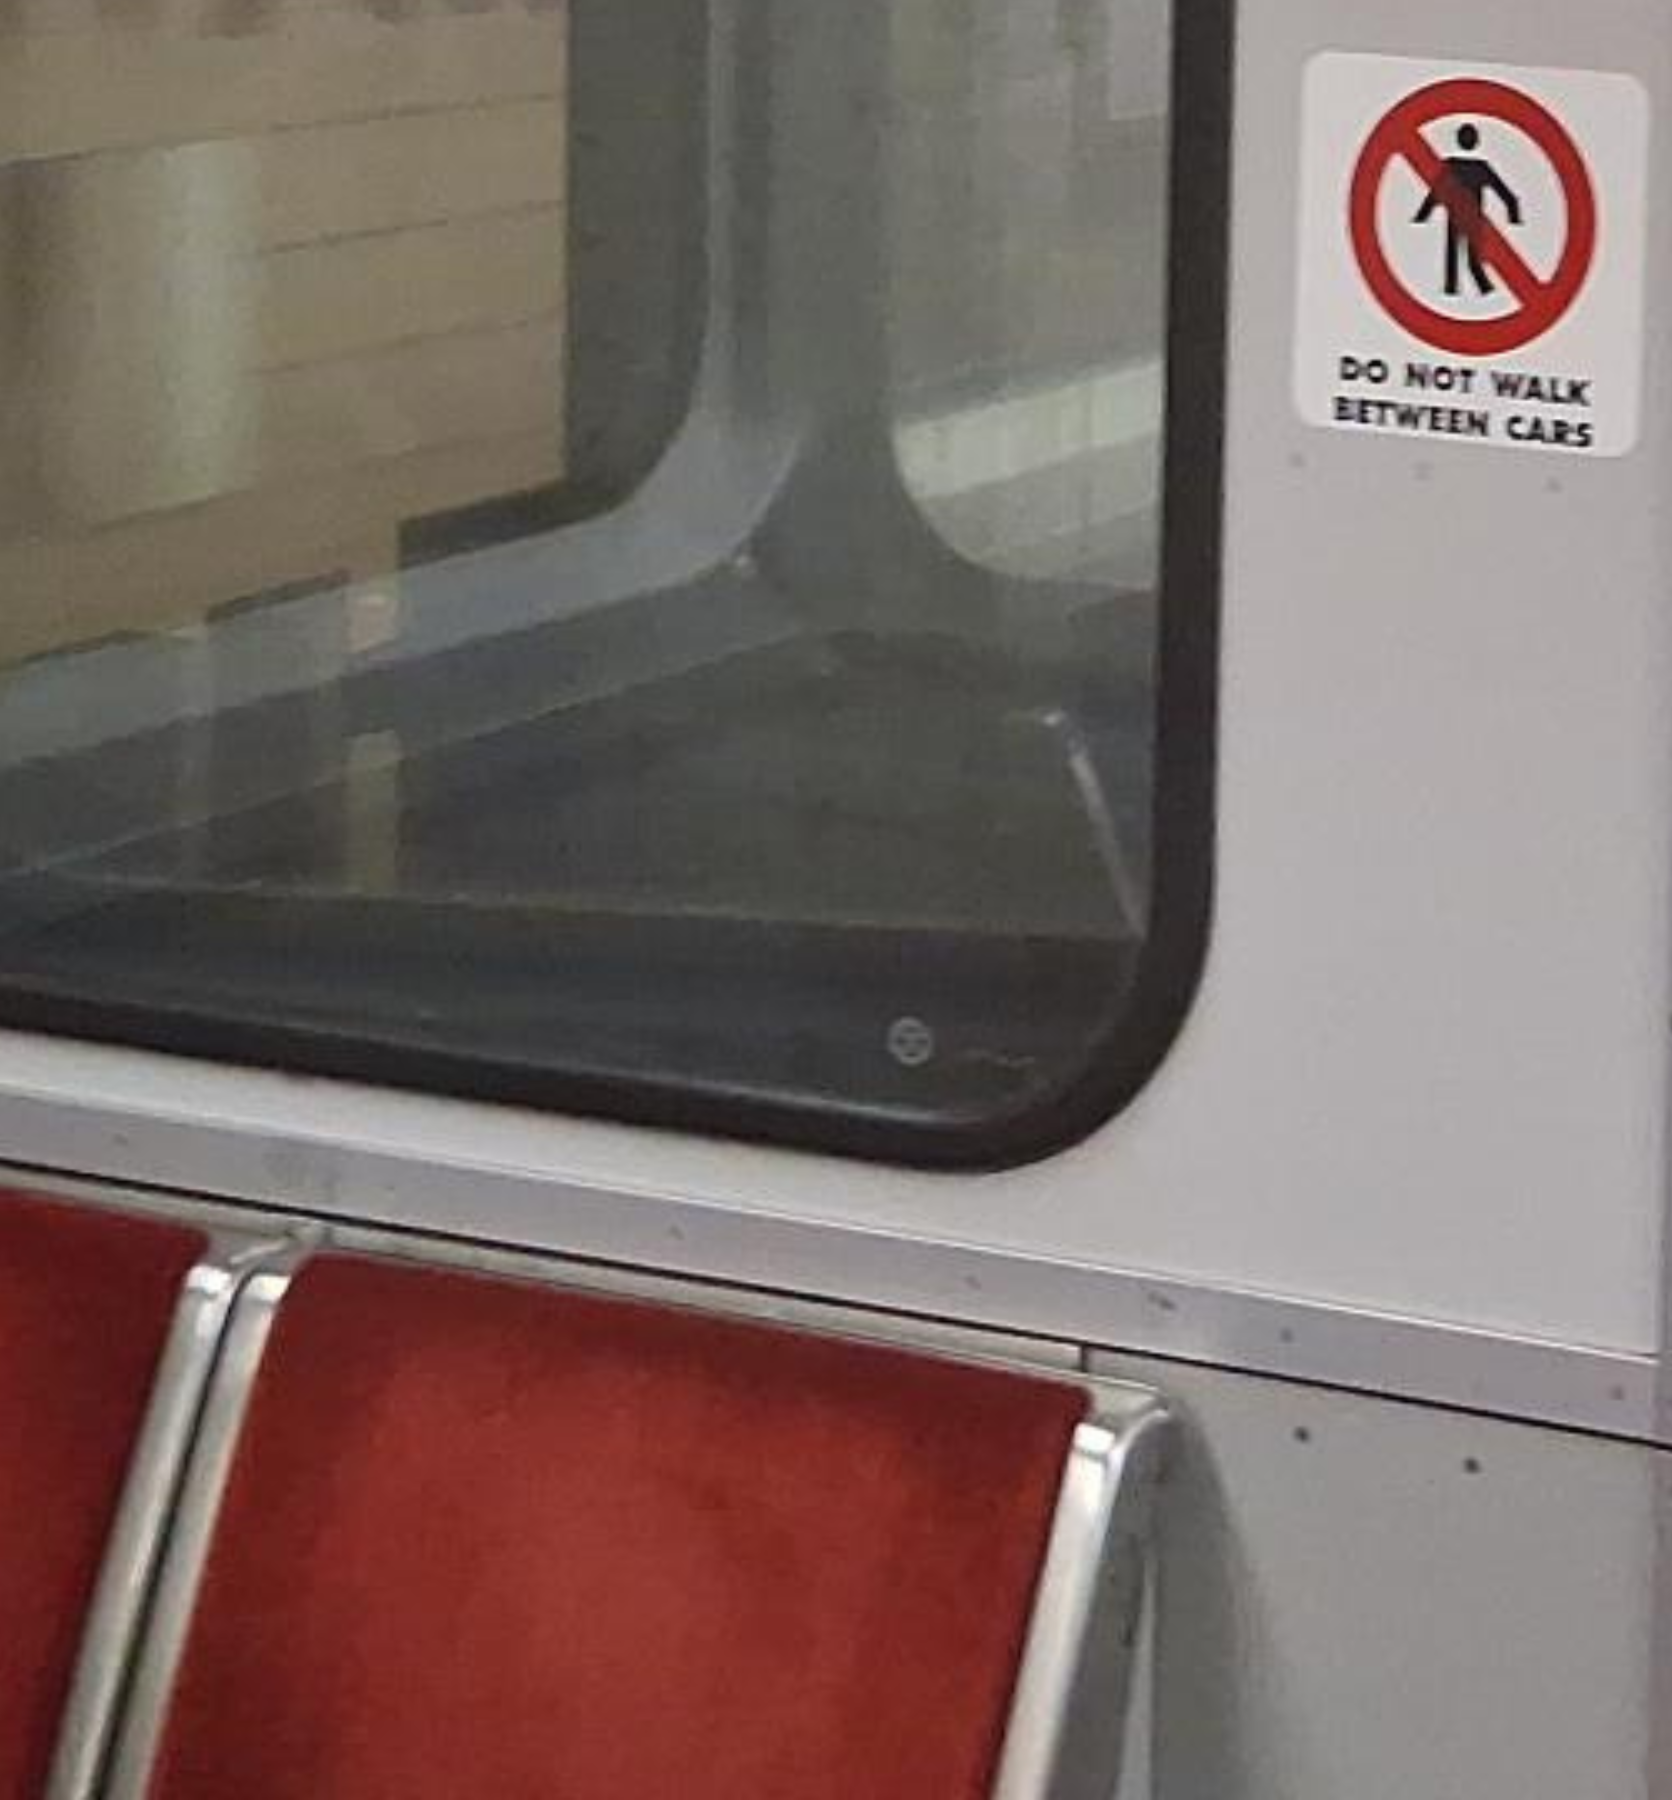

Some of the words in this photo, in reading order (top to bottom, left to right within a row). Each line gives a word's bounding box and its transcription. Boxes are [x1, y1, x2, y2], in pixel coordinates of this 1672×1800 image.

[1339, 355, 1389, 383] DO
[1406, 362, 1475, 394] NOT
[1490, 372, 1592, 406] WALK
[1333, 396, 1490, 437] BETWEEN
[1506, 414, 1594, 448] CARS
